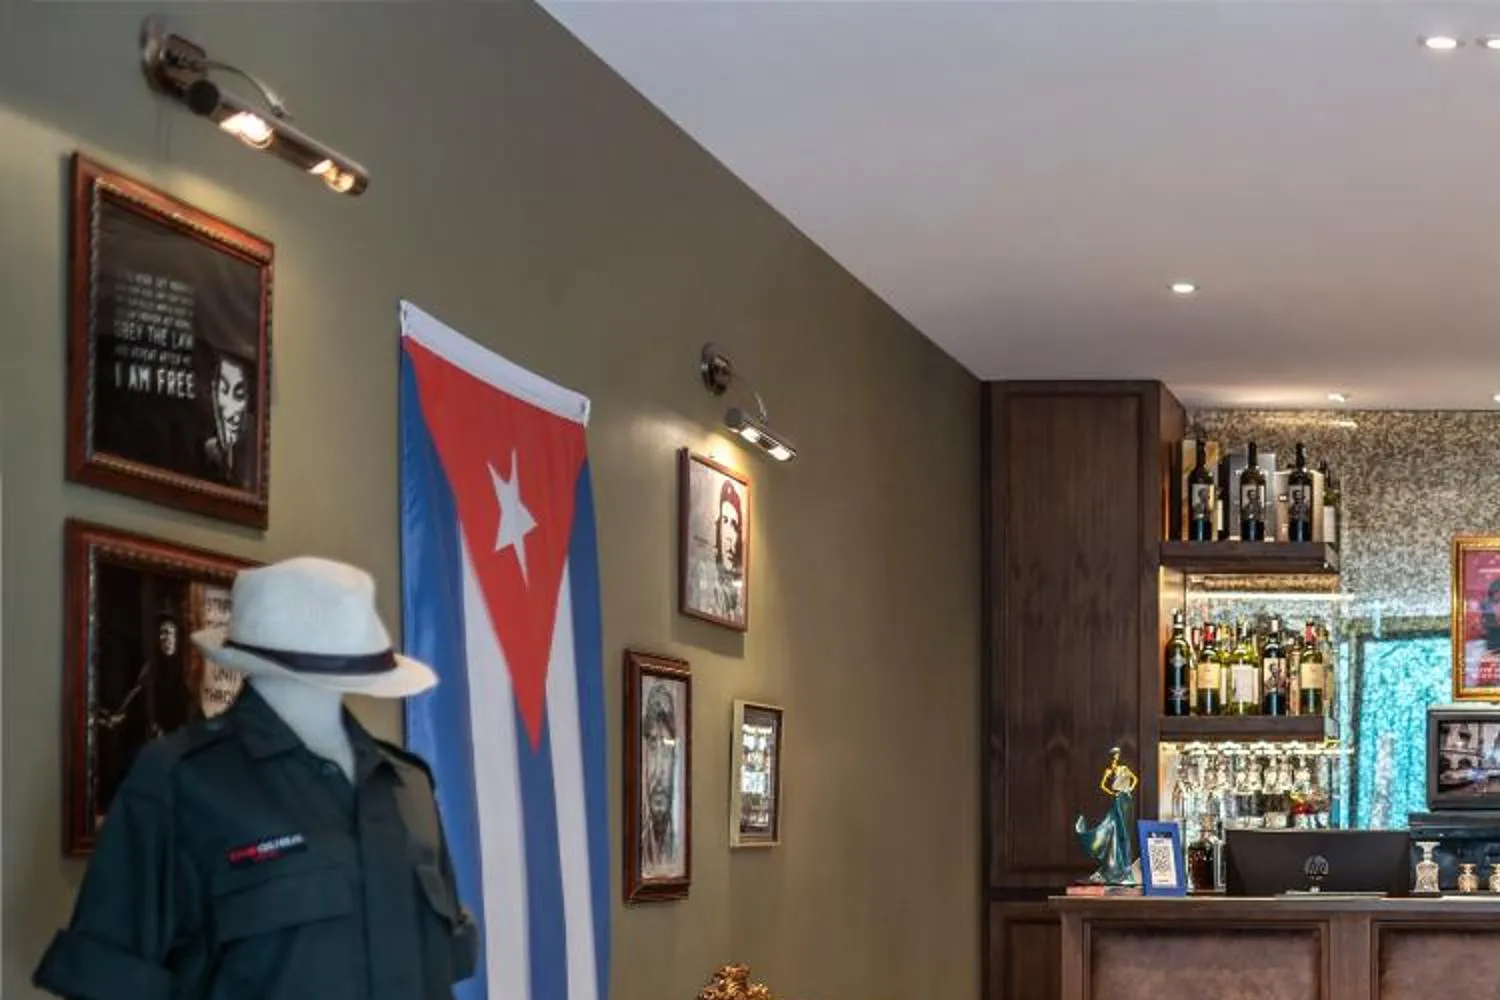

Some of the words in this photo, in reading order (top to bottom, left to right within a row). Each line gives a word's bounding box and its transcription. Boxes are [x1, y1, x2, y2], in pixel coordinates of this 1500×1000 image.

[115, 361, 122, 388] I
[128, 364, 151, 392] AM
[157, 367, 196, 399] FREE
